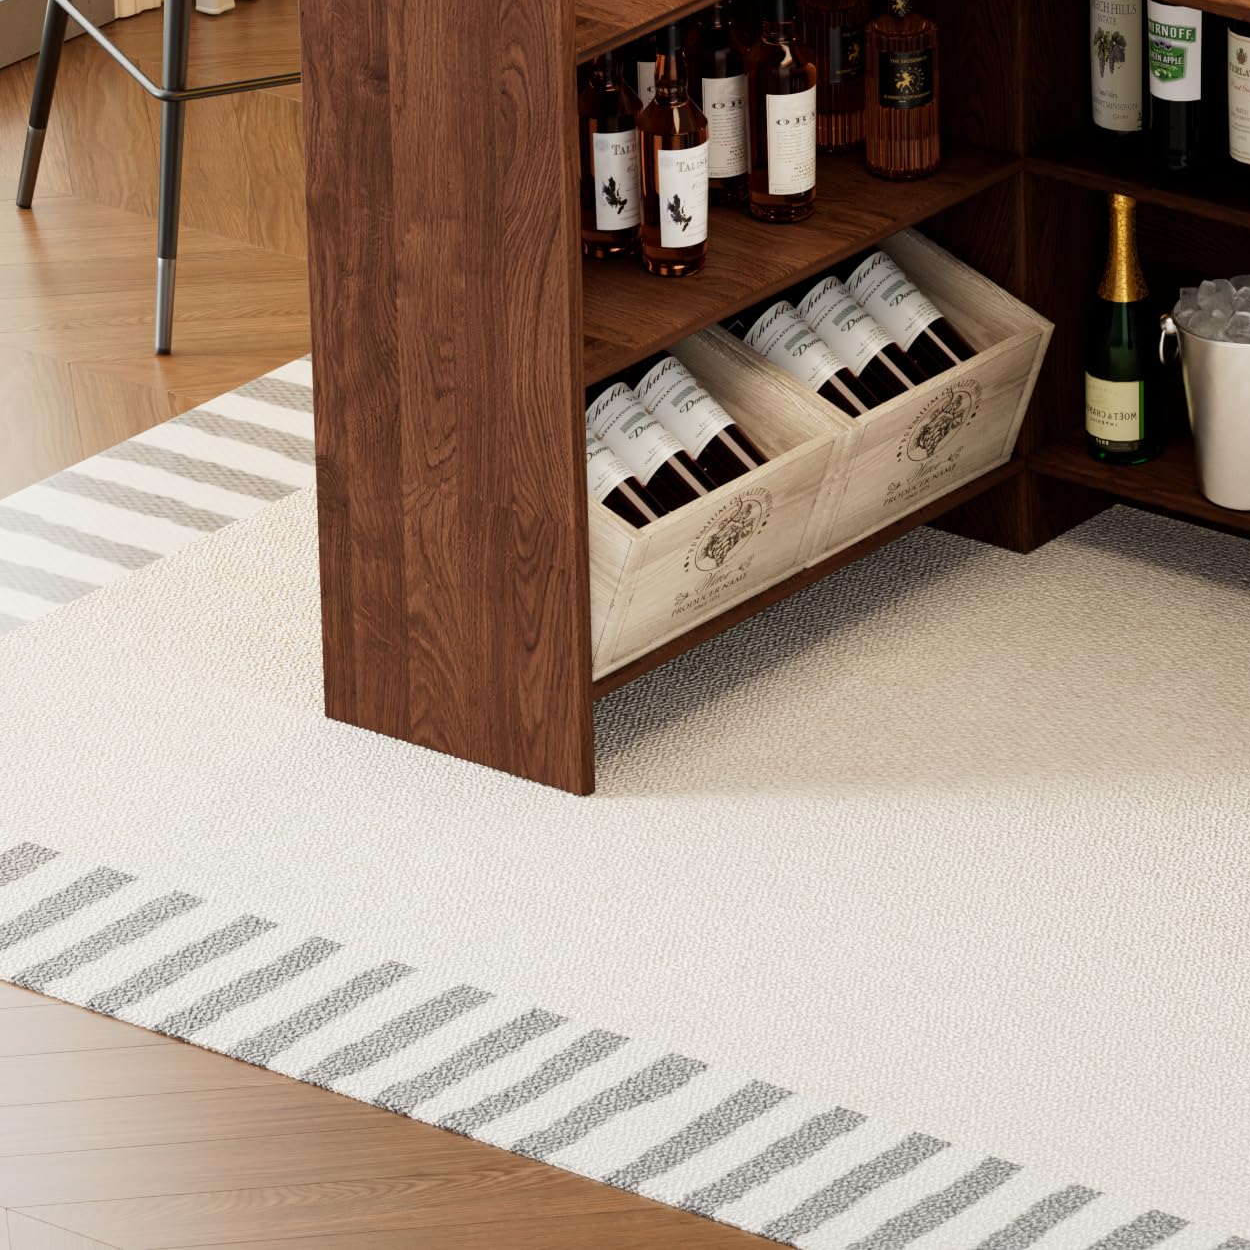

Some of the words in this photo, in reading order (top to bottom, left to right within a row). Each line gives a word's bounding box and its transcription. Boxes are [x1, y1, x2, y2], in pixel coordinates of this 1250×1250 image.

[1110, 3, 1137, 15] HILLS
[1151, 23, 1192, 40] IRNOFF
[1163, 55, 1183, 65] APPLE
